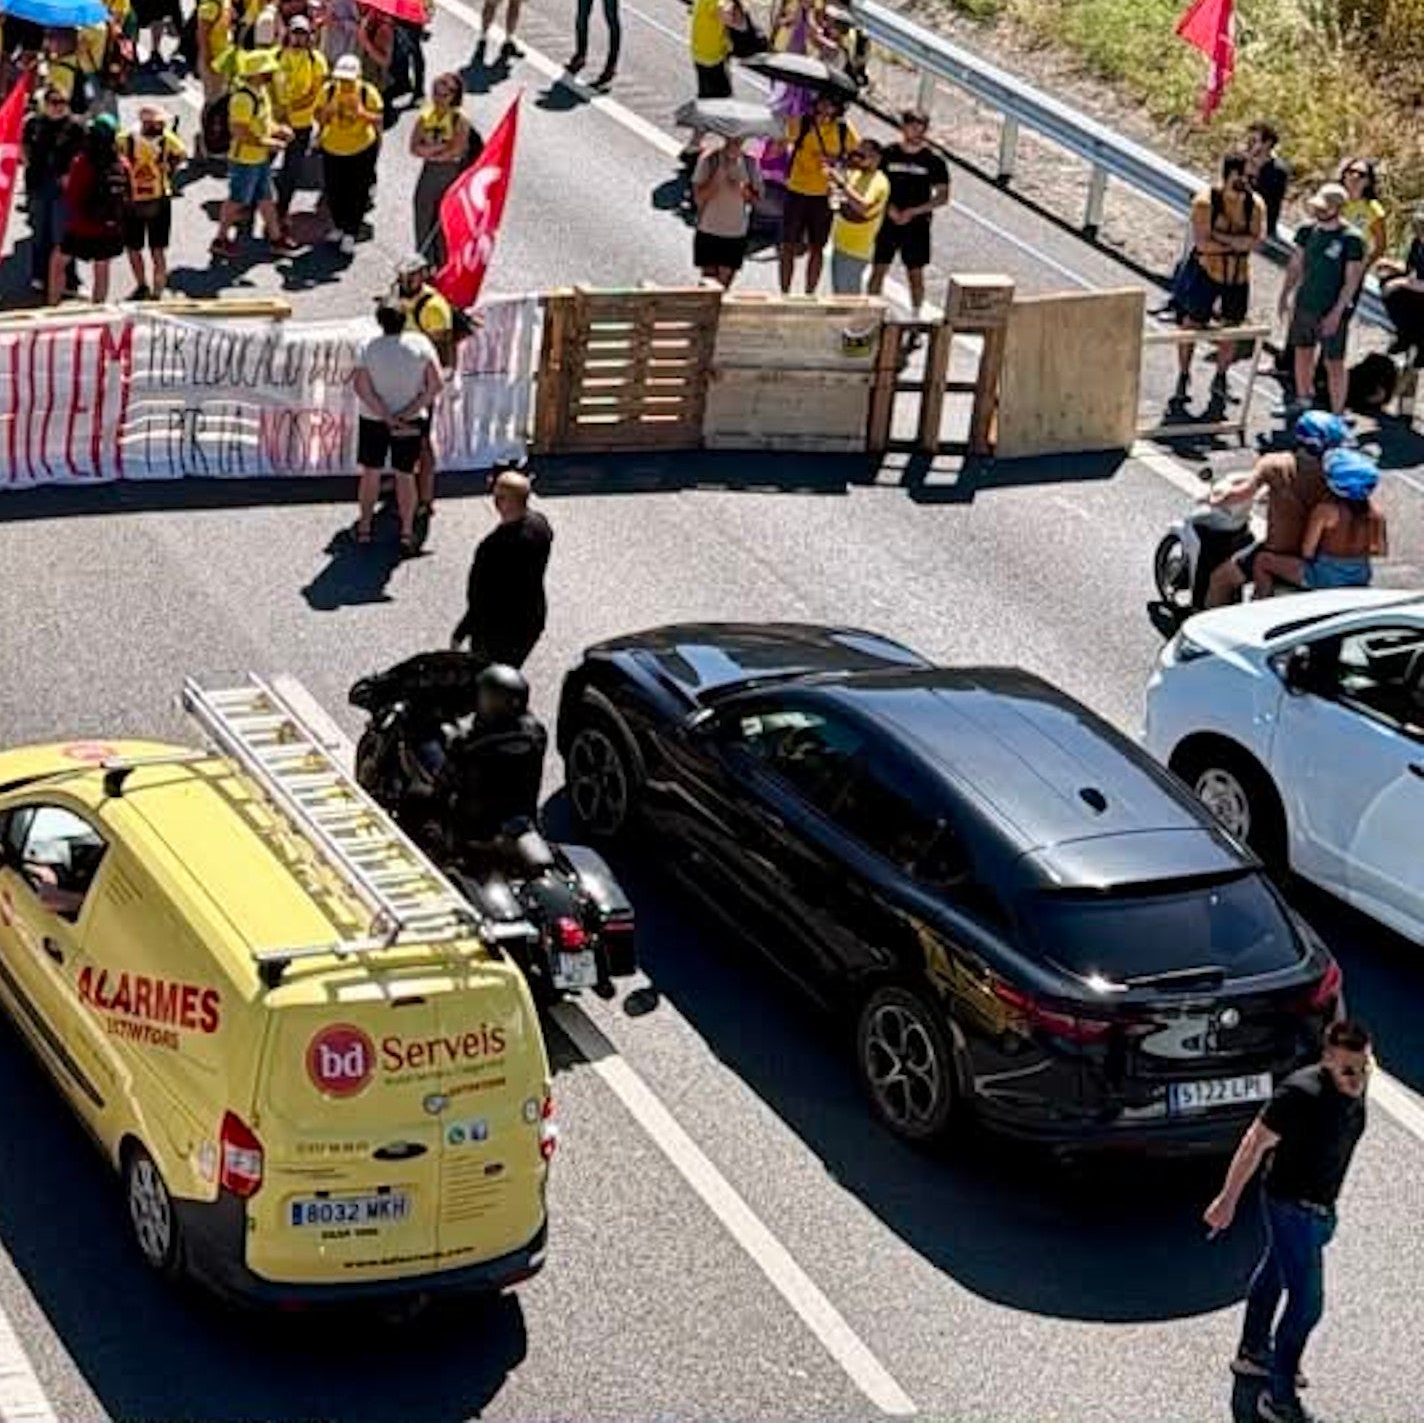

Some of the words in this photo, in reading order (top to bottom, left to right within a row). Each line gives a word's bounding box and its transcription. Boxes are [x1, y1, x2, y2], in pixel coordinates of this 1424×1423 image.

[76, 966, 221, 1033] ALARMES
[320, 1043, 363, 1078] bd
[381, 1021, 506, 1072] Serveis
[307, 1202, 359, 1223] 8032
[366, 1196, 405, 1219] MKH
